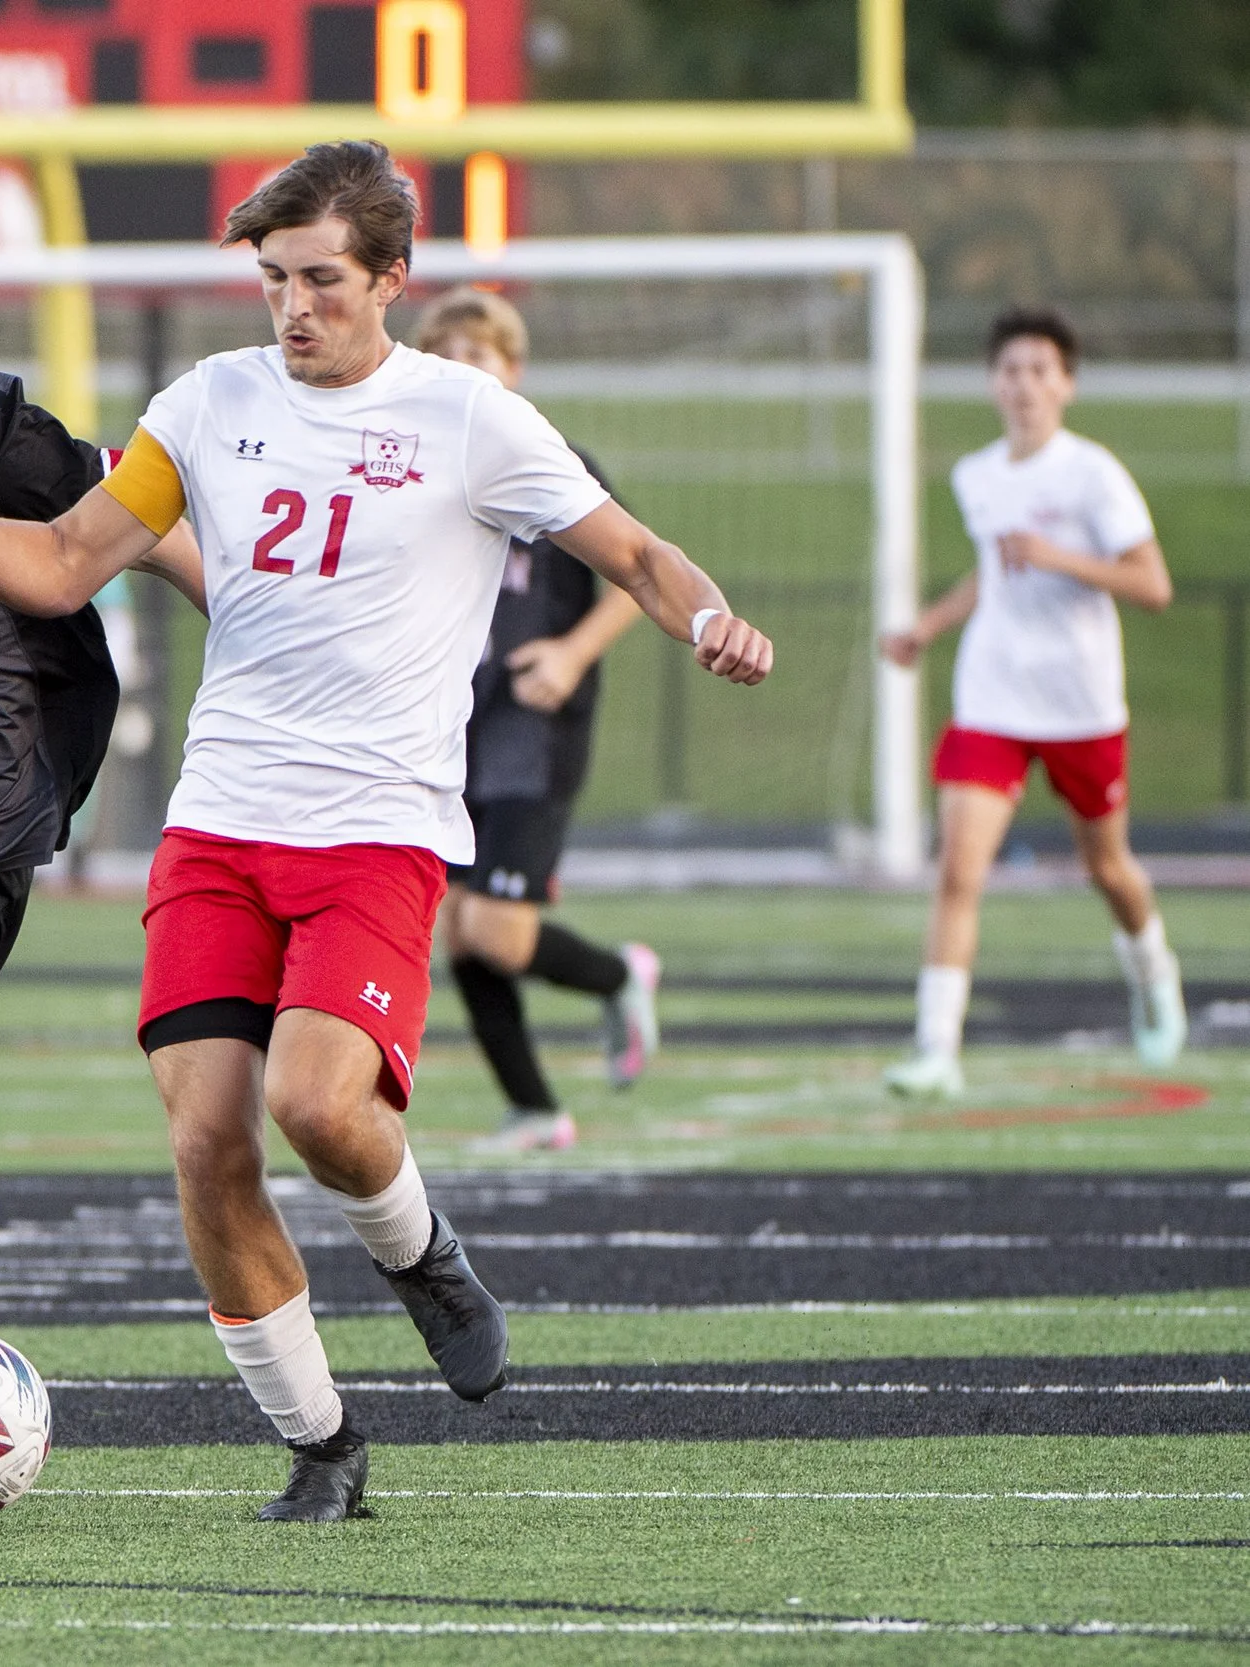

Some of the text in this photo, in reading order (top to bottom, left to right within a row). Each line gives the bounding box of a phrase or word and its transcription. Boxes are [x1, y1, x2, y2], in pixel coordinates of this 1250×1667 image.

[375, 0, 466, 127] 0
[370, 460, 404, 474] GHS
[252, 488, 354, 578] 21
